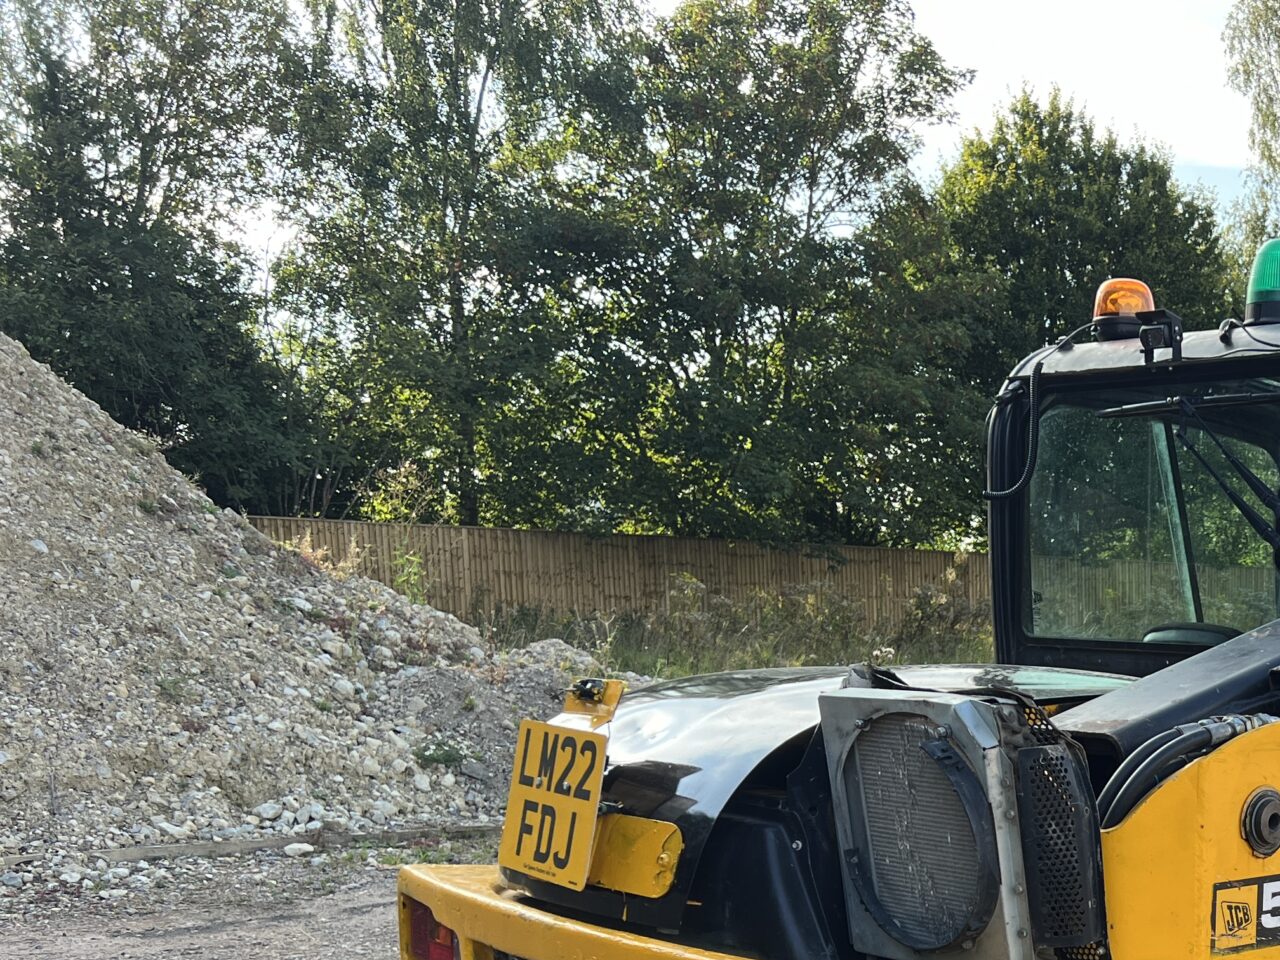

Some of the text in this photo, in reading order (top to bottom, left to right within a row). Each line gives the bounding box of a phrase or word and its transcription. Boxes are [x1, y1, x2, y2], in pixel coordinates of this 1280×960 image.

[518, 728, 597, 801] LM22
[515, 799, 577, 870] FDJ
[1226, 904, 1250, 931] JCB
